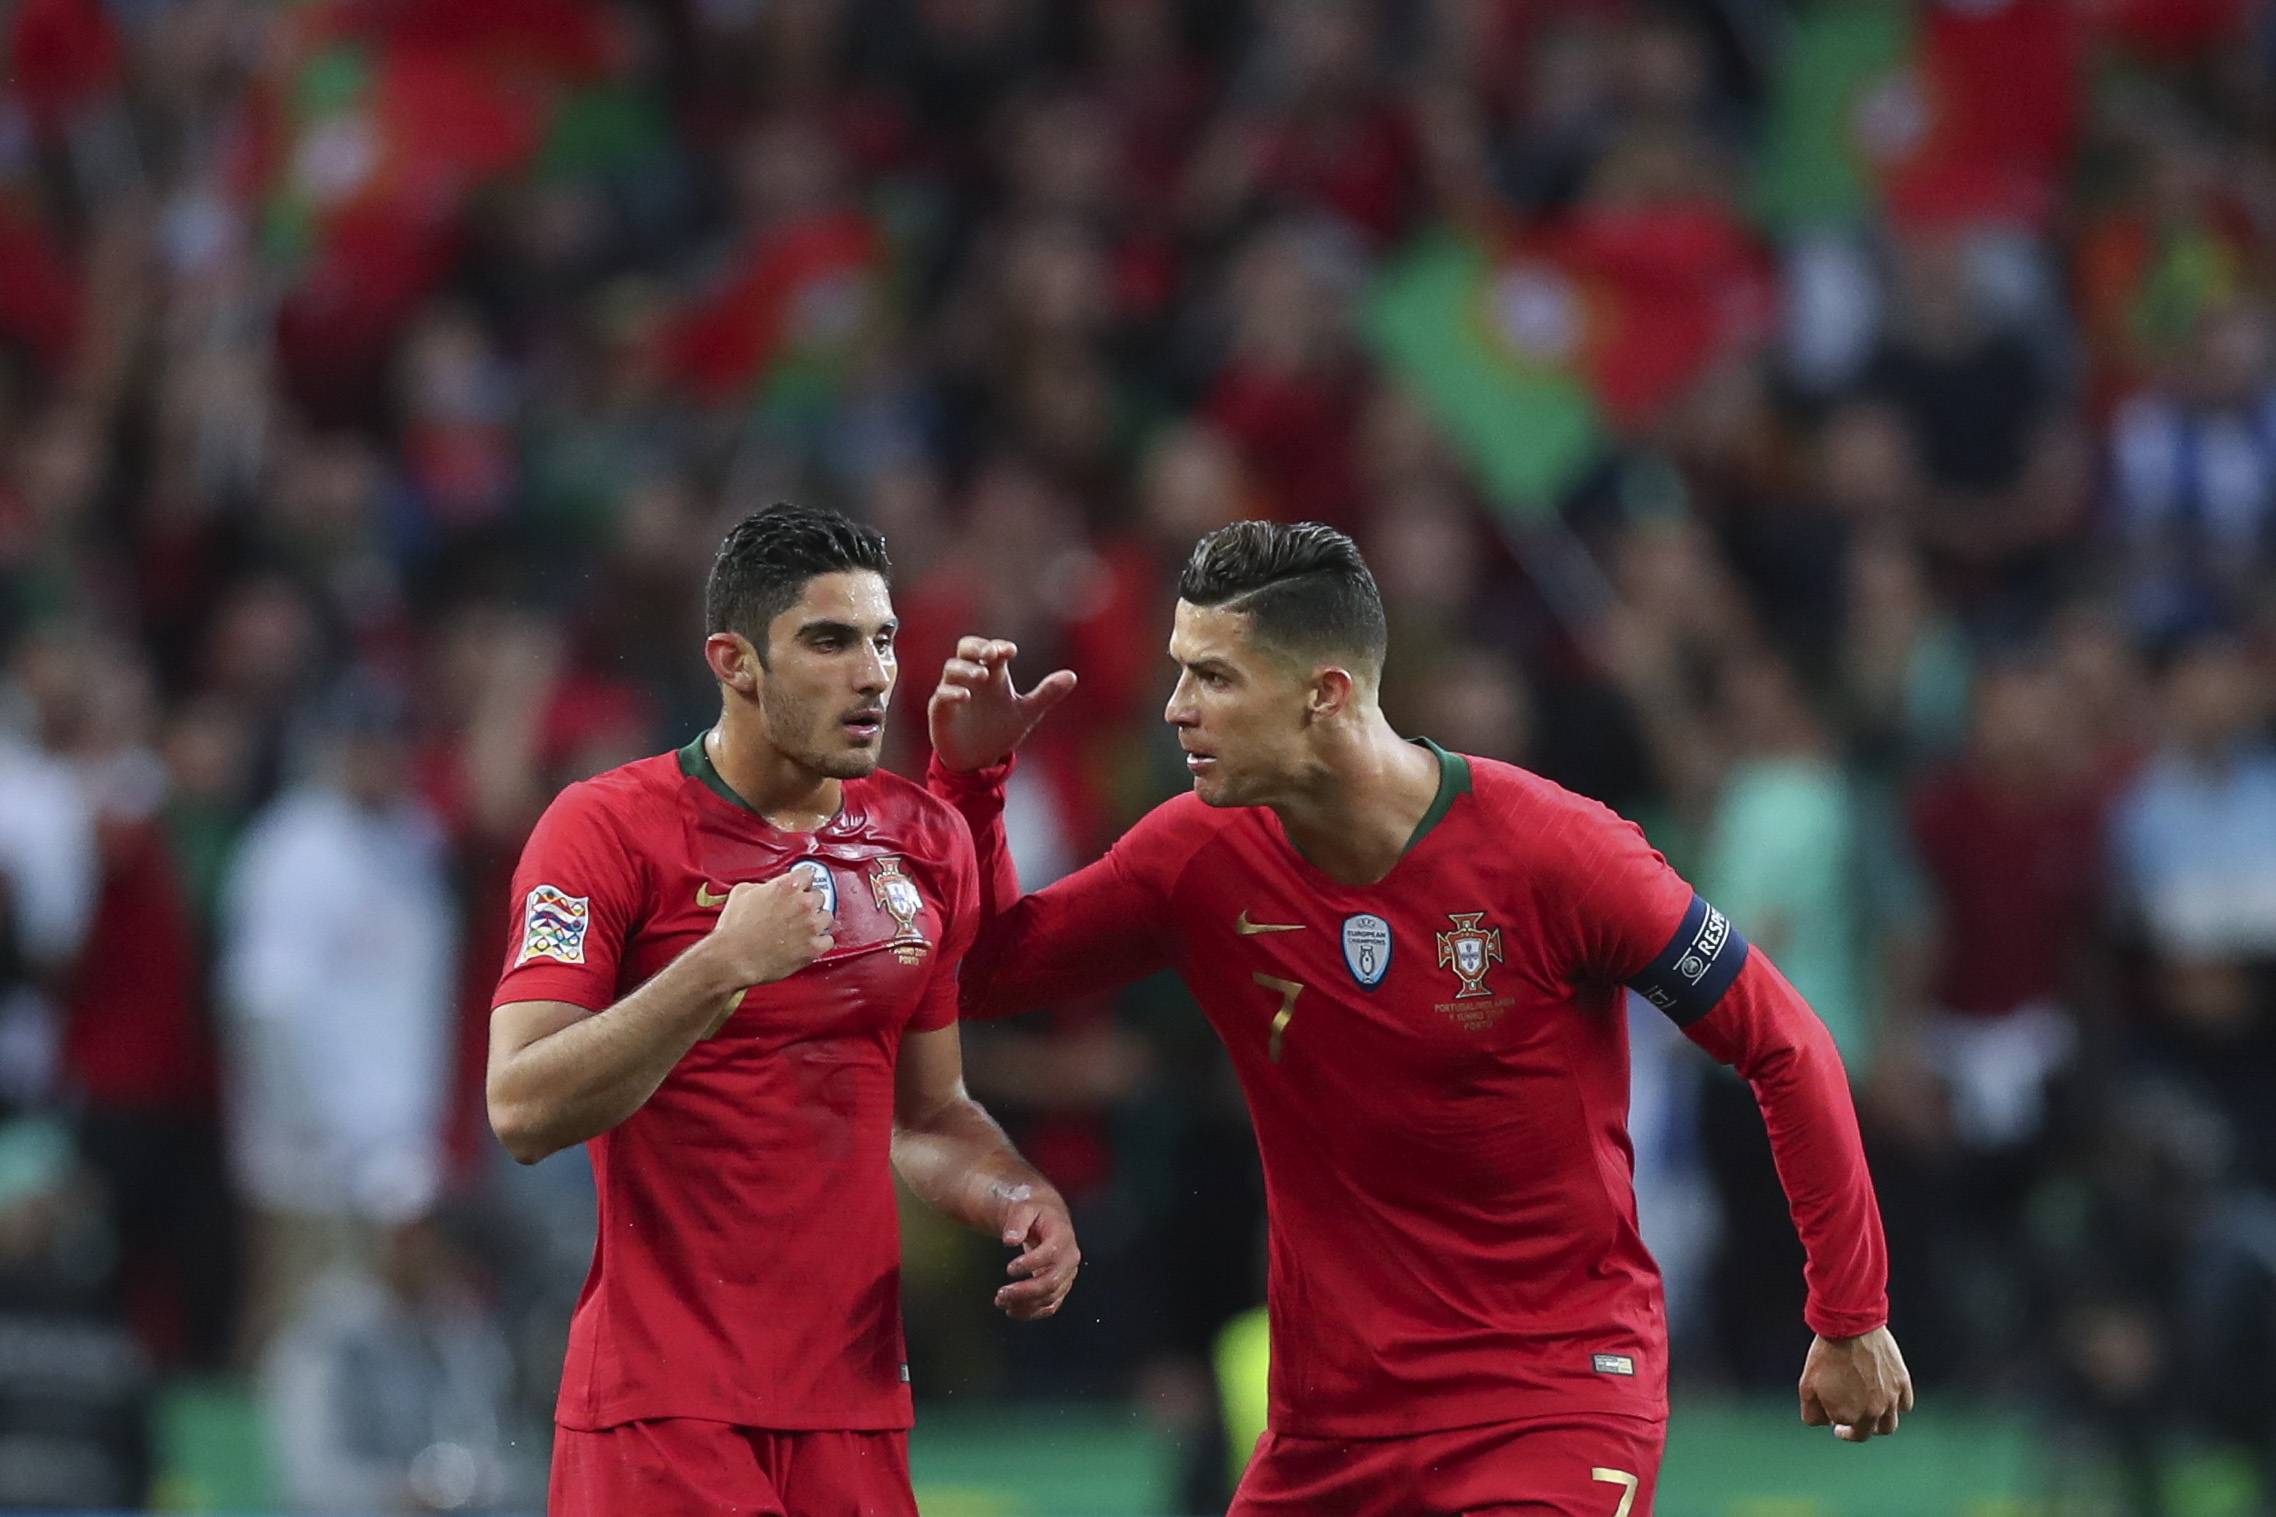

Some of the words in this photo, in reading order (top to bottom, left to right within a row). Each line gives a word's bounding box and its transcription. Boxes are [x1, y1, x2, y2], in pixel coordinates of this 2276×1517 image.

[1698, 906, 1725, 956] RESP
[1252, 971, 1304, 1065] 7
[1591, 1467, 1639, 1517] 7
